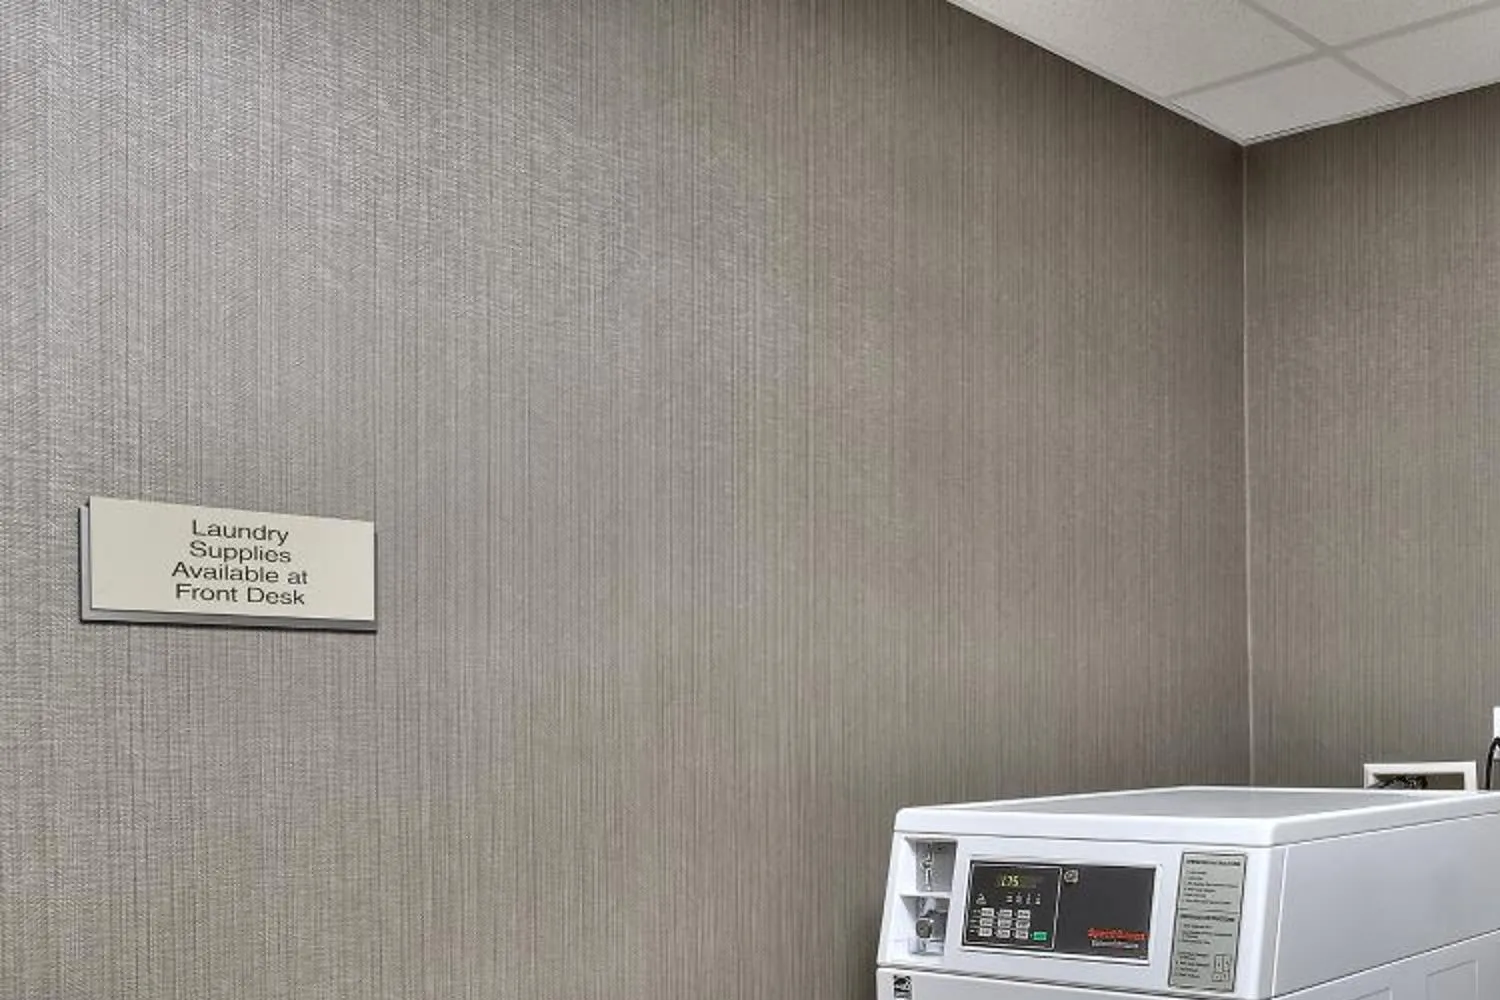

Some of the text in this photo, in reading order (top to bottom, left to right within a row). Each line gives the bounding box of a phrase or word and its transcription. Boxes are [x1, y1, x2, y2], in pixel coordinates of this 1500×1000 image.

[192, 519, 289, 546] Laundry
[189, 541, 292, 564] Supplies
[172, 561, 308, 585] Available at
[176, 584, 305, 605] Front Desk
